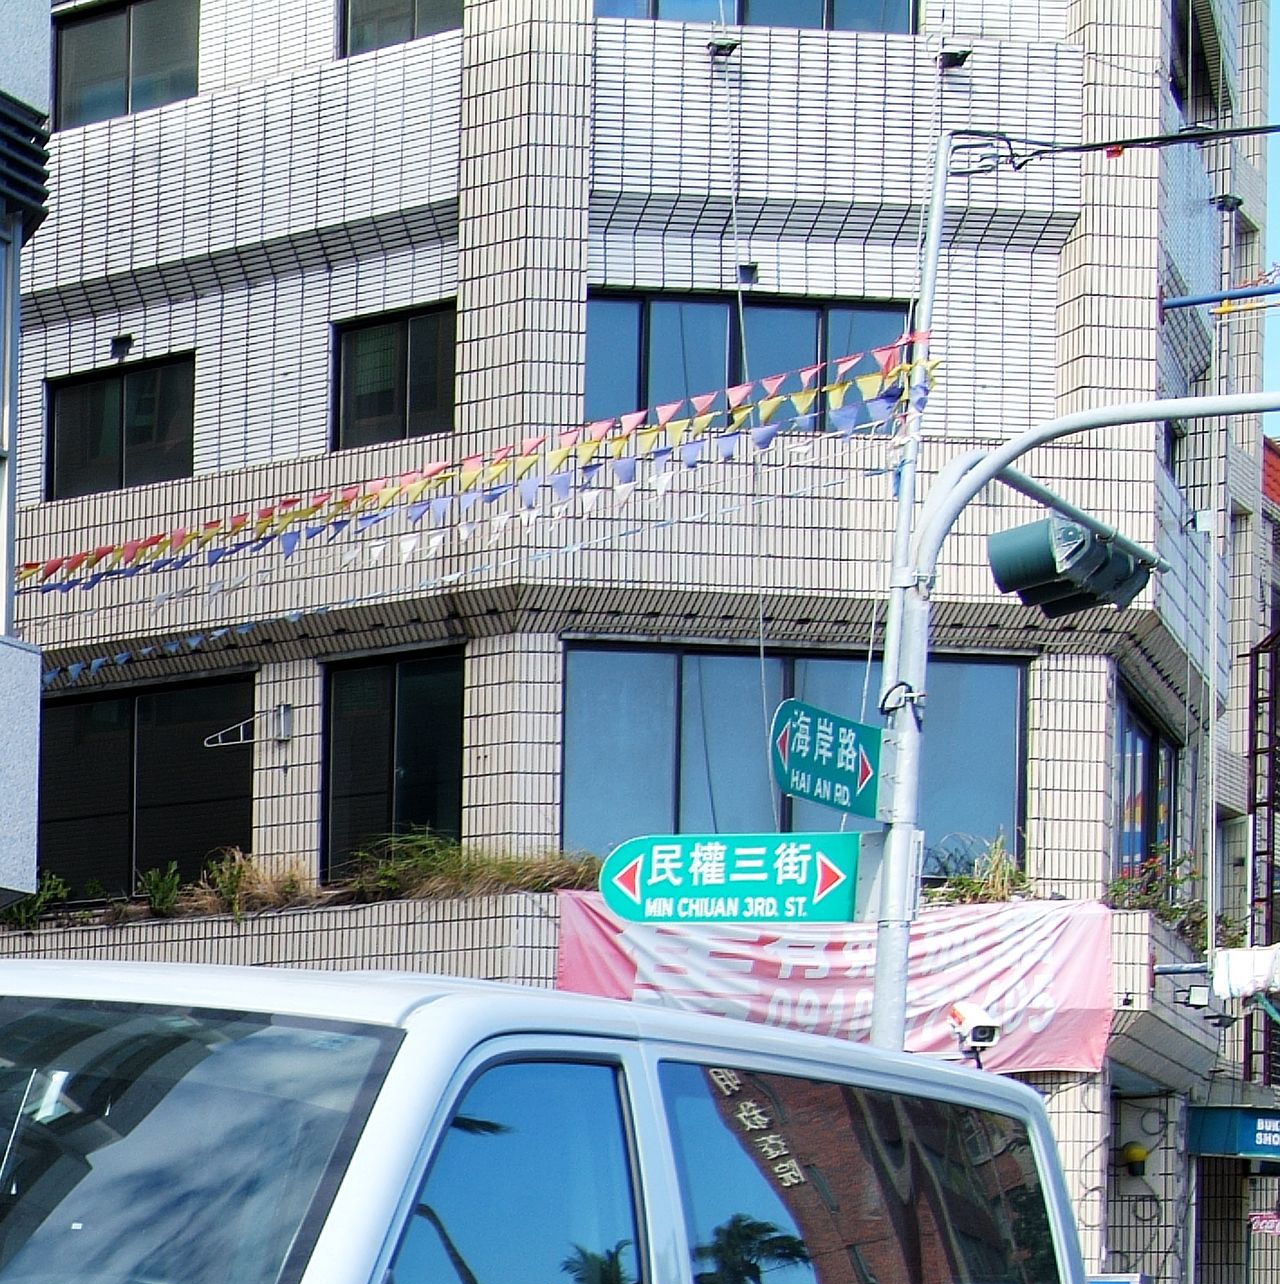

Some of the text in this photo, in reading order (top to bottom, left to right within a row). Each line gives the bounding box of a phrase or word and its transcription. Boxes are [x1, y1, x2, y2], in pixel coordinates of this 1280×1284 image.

[790, 708, 858, 773] 海岸路
[790, 769, 811, 794] HAI
[813, 778, 831, 801] AN
[646, 841, 813, 887] 民權三街
[644, 896, 674, 918] MIN
[784, 895, 807, 917] ST.
